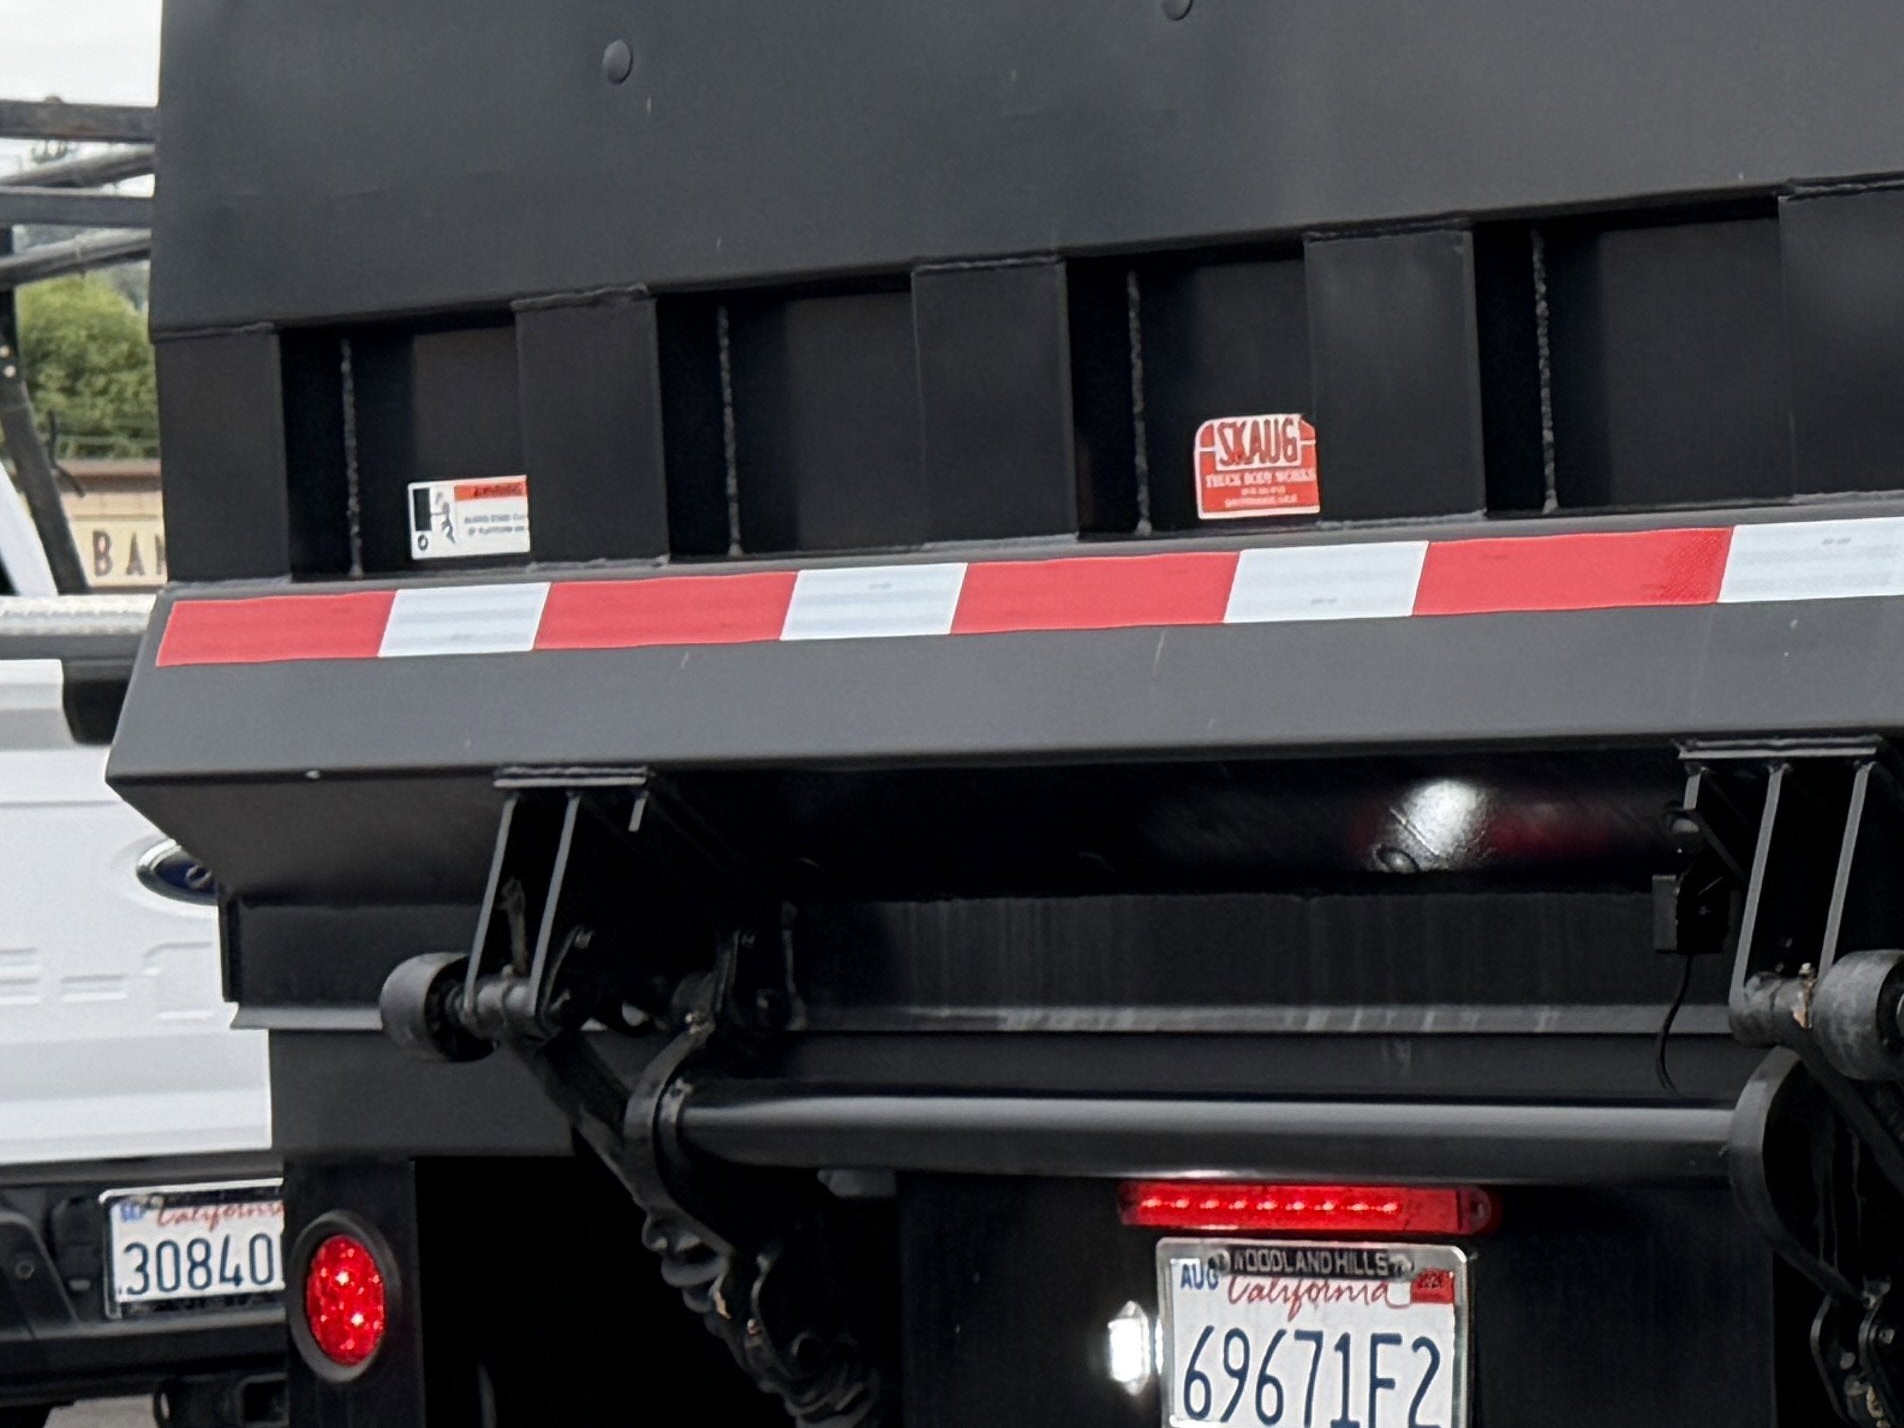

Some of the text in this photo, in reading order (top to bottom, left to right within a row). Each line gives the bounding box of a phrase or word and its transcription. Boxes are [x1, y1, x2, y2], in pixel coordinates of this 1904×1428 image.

[1217, 417, 1299, 466] SKAUG
[123, 1233, 274, 1295] 30840
[1180, 1264, 1219, 1290] AUG
[1234, 1248, 1389, 1276] WOODLAND HILLS
[1228, 1275, 1411, 1322] California
